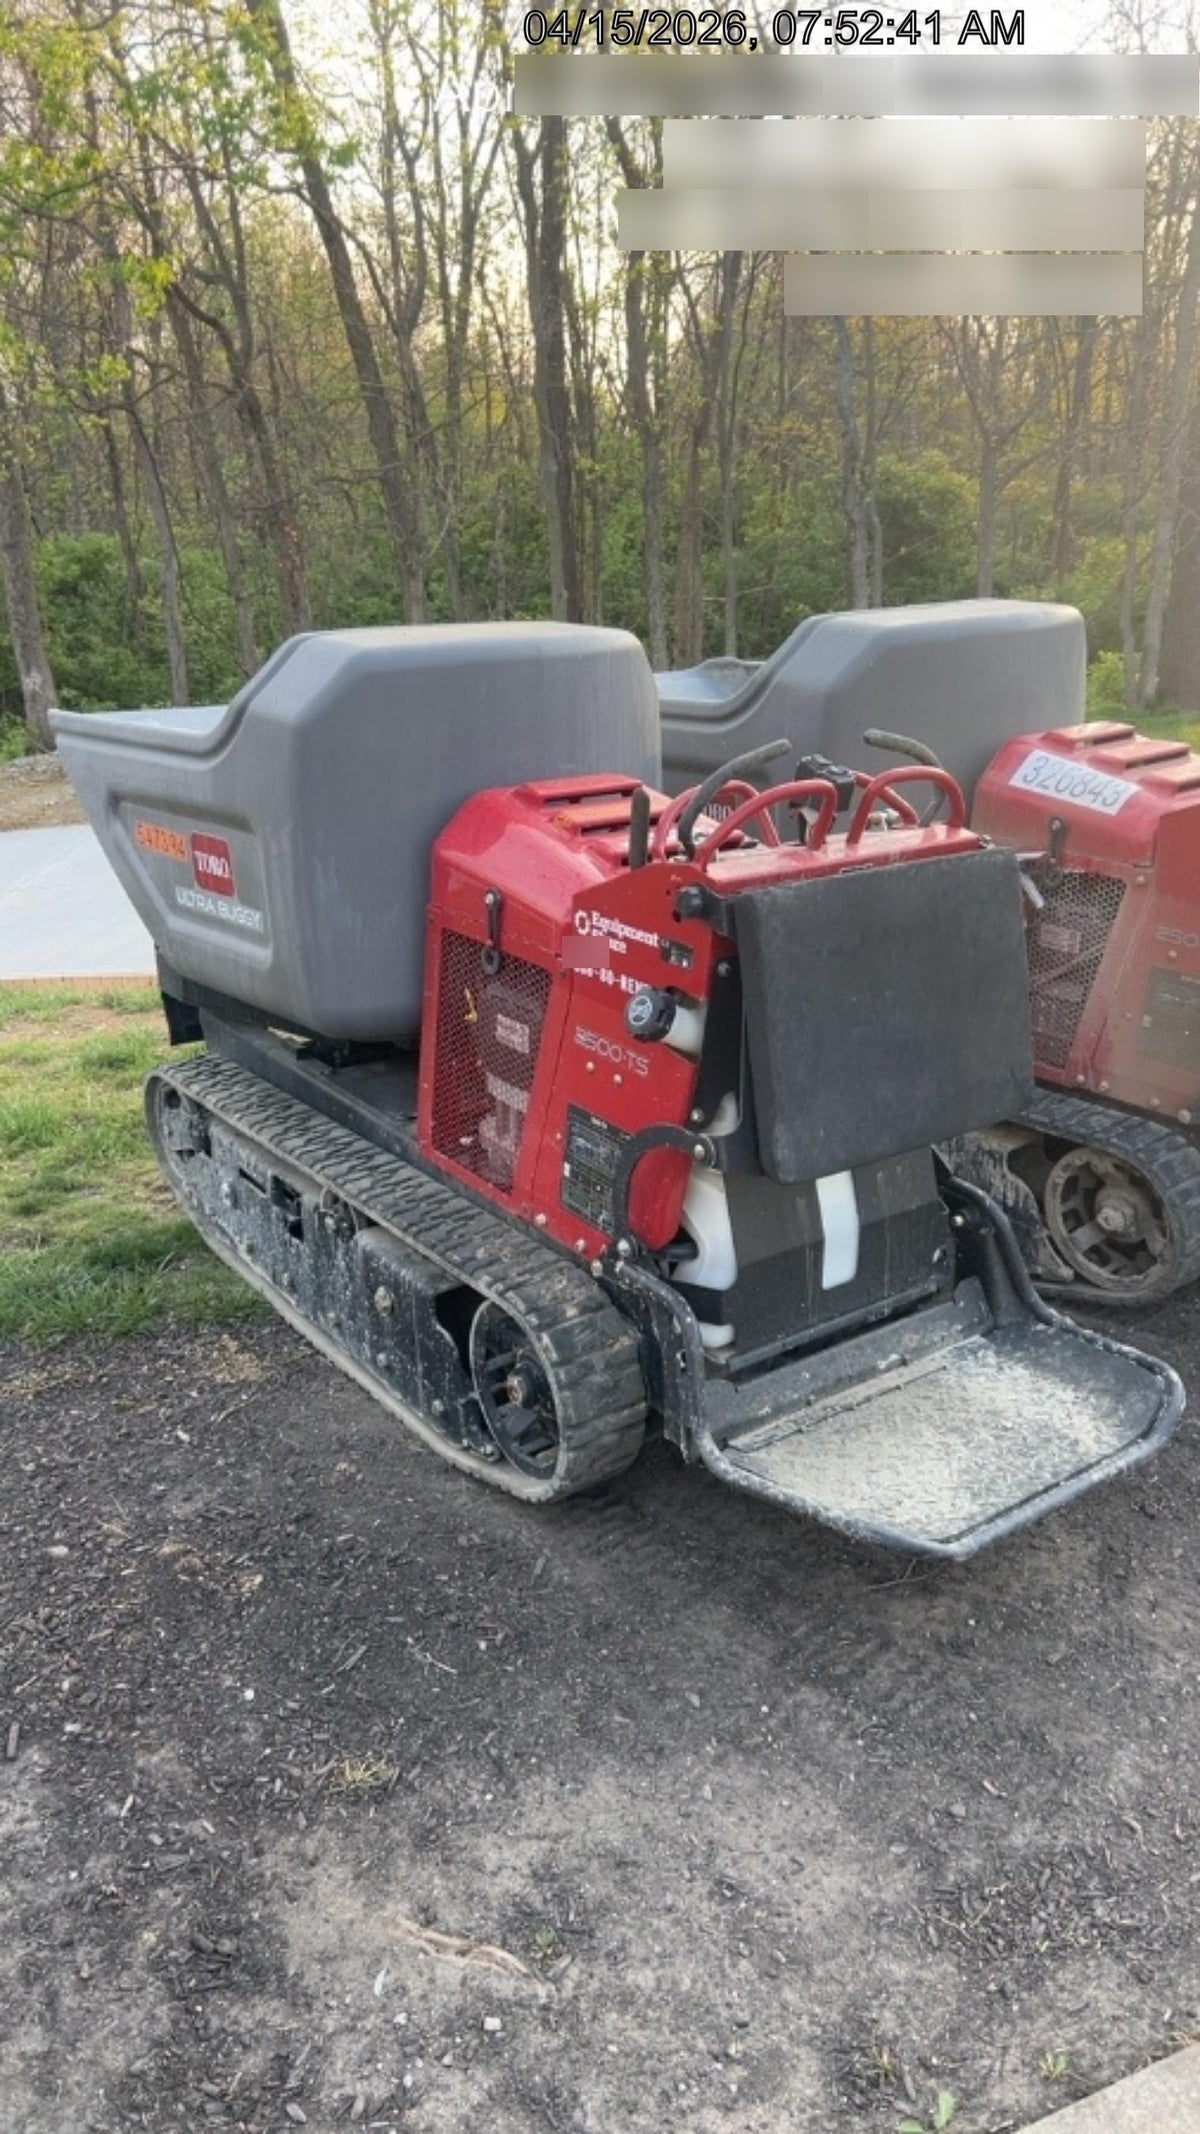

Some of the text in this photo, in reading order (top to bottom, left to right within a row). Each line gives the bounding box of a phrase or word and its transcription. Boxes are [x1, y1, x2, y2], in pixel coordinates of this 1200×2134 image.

[194, 850, 231, 878] TORO
[175, 885, 264, 933] ULTRA BUGGY
[591, 910, 660, 949] Equipment
